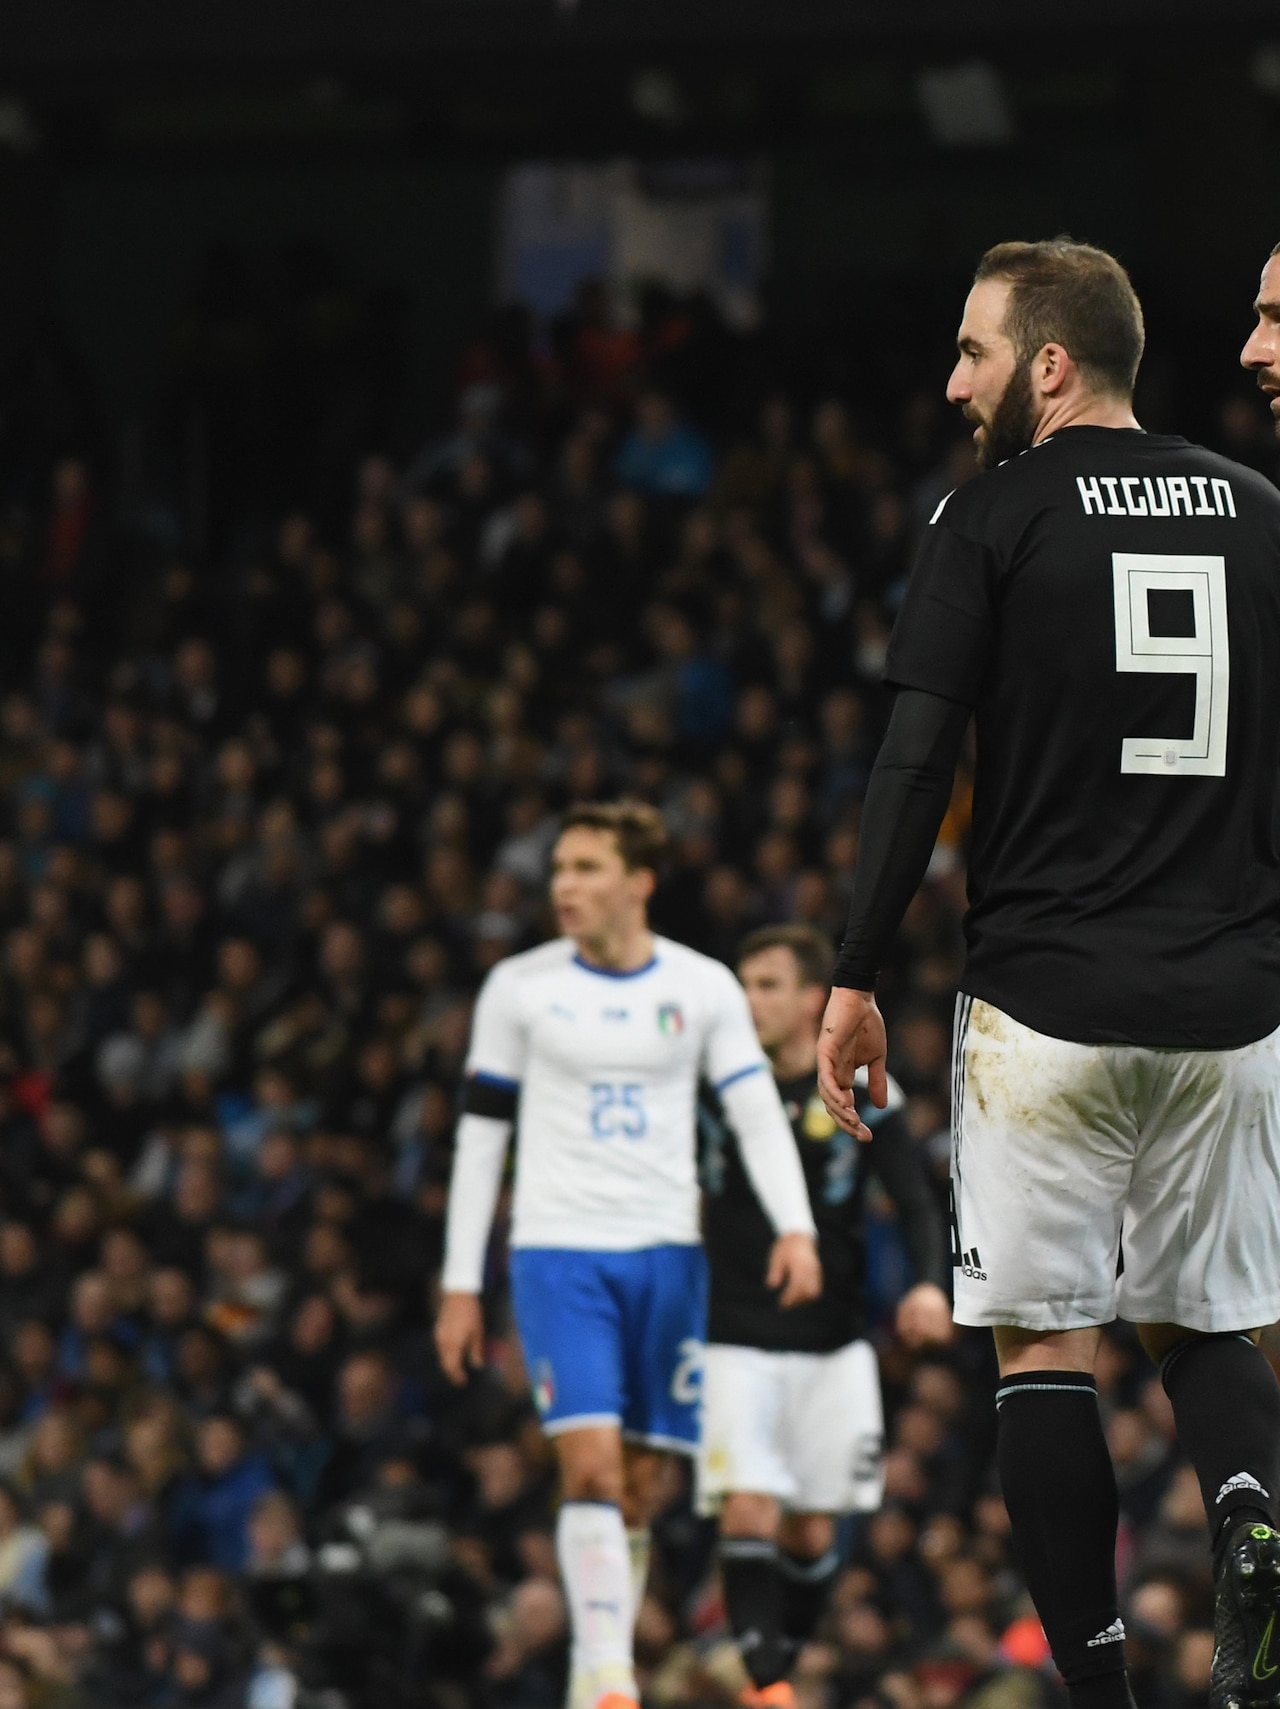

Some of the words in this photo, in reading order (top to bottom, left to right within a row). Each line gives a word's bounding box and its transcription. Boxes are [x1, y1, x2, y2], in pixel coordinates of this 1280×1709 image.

[1076, 476, 1236, 518] HIGUAIN
[1112, 552, 1228, 776] 9
[589, 1082, 647, 1139] 25
